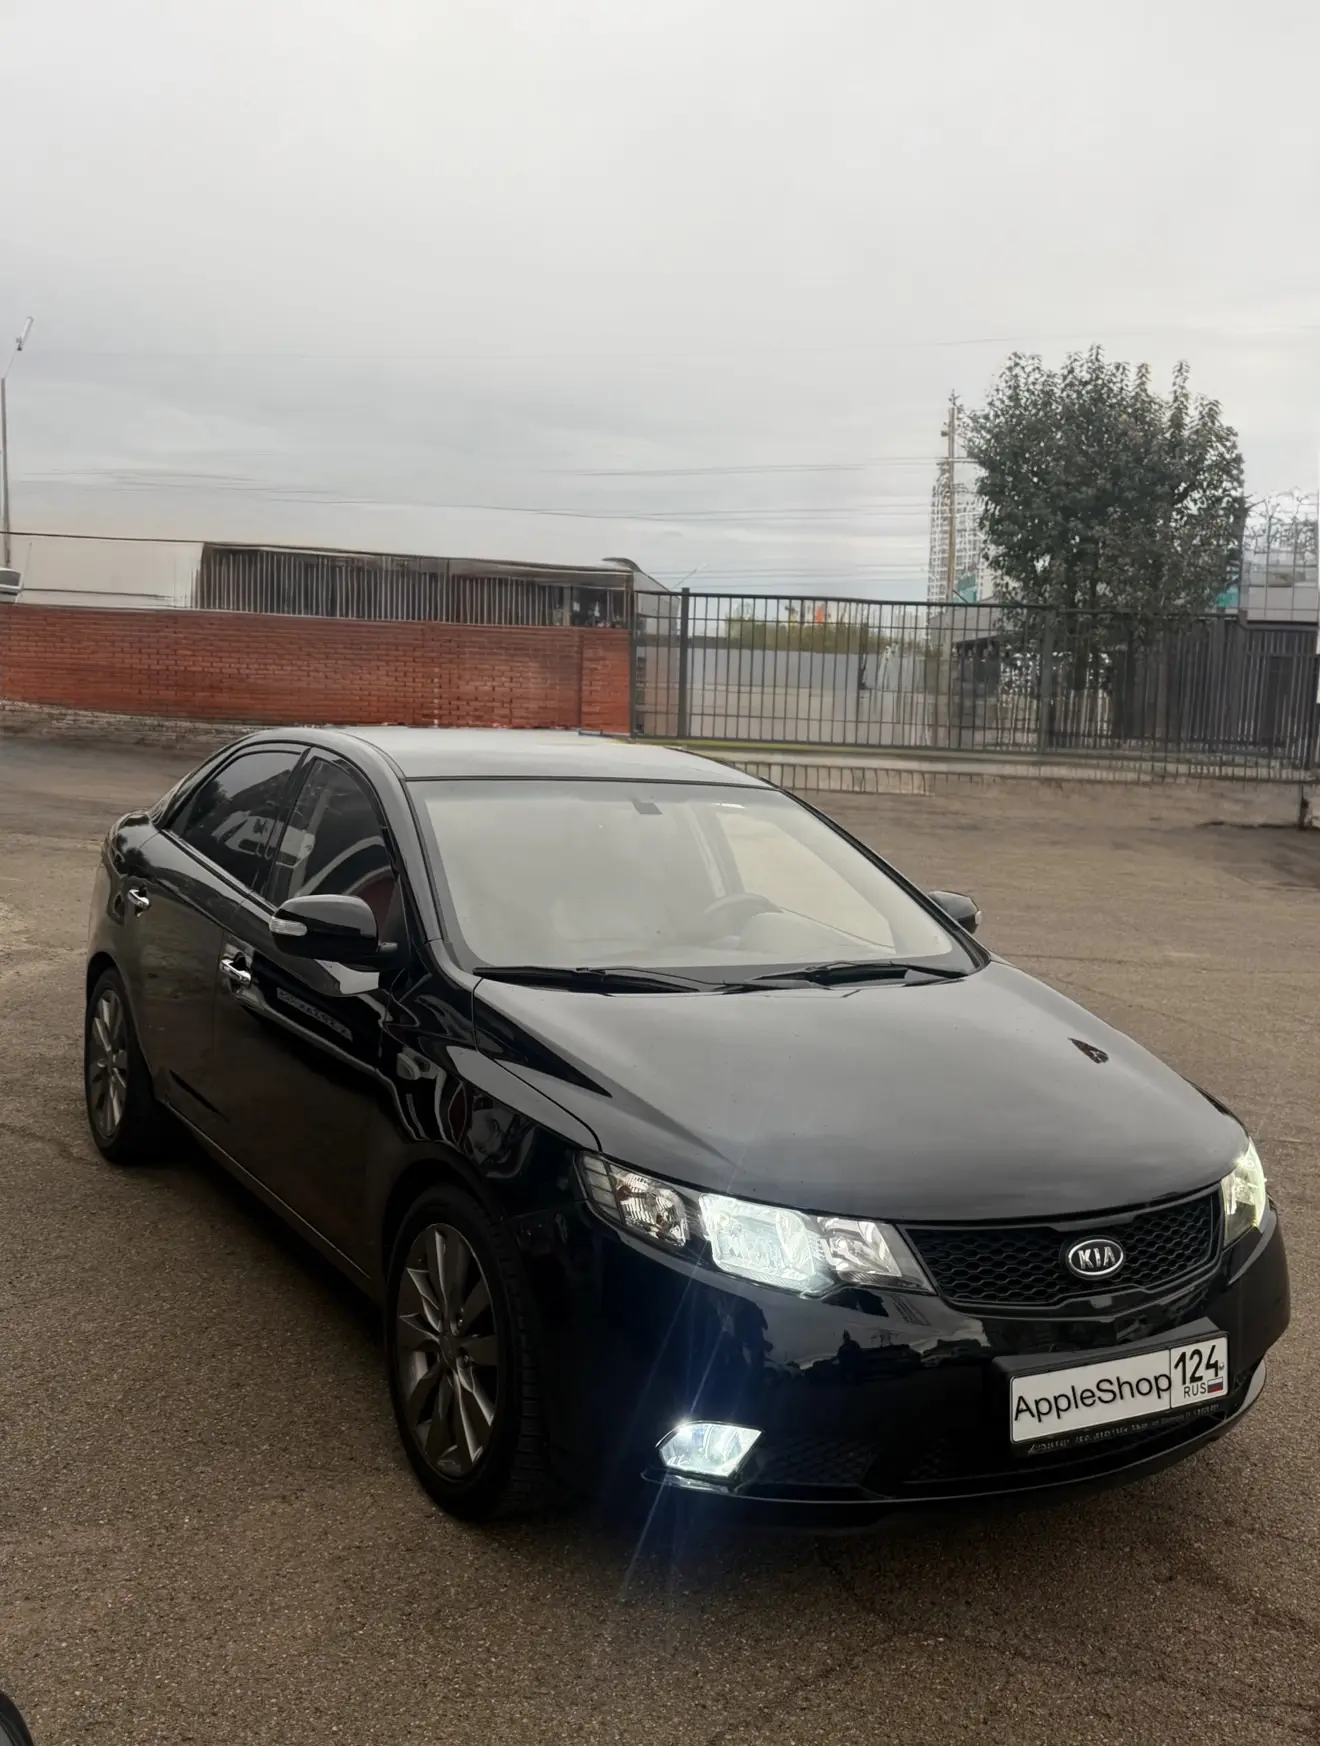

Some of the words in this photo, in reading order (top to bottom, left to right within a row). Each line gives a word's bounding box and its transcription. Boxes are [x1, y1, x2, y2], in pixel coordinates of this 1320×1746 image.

[1077, 1246, 1116, 1270] KIA
[1014, 1373, 1172, 1423] AppleShop
[1174, 1344, 1219, 1386] 124
[1183, 1382, 1206, 1399] RUS
